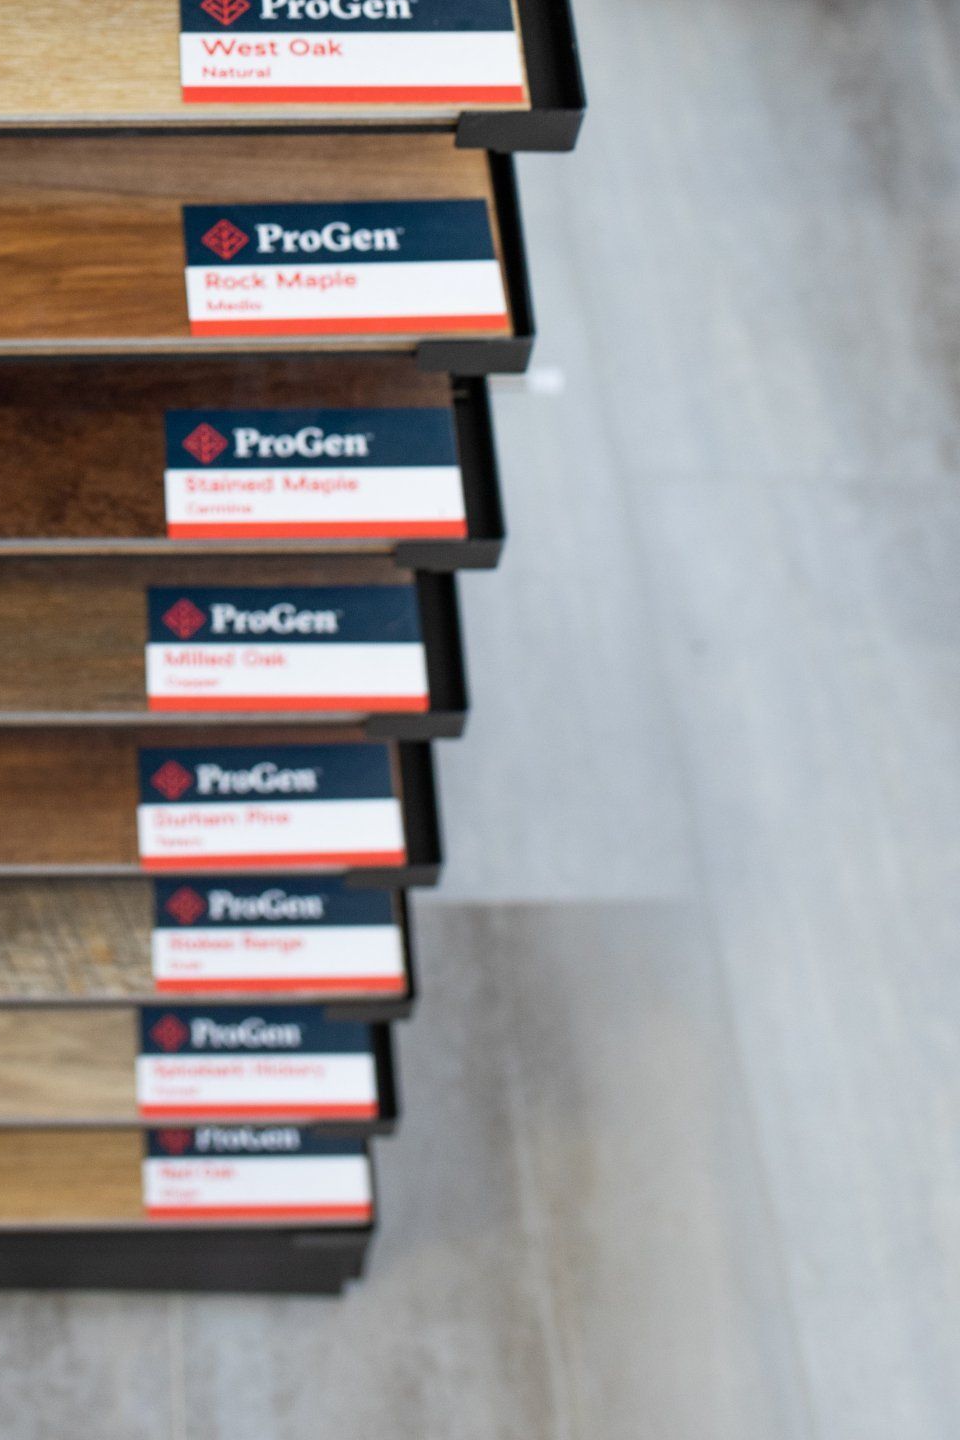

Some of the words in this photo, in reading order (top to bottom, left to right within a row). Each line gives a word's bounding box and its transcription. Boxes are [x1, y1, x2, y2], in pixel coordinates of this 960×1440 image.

[201, 38, 278, 58] West
[289, 38, 343, 56] Oak
[201, 66, 271, 79] Natural
[204, 272, 265, 290] Rock
[276, 271, 358, 292] Maple
[184, 475, 274, 493] Stained
[283, 475, 359, 495] Maple
